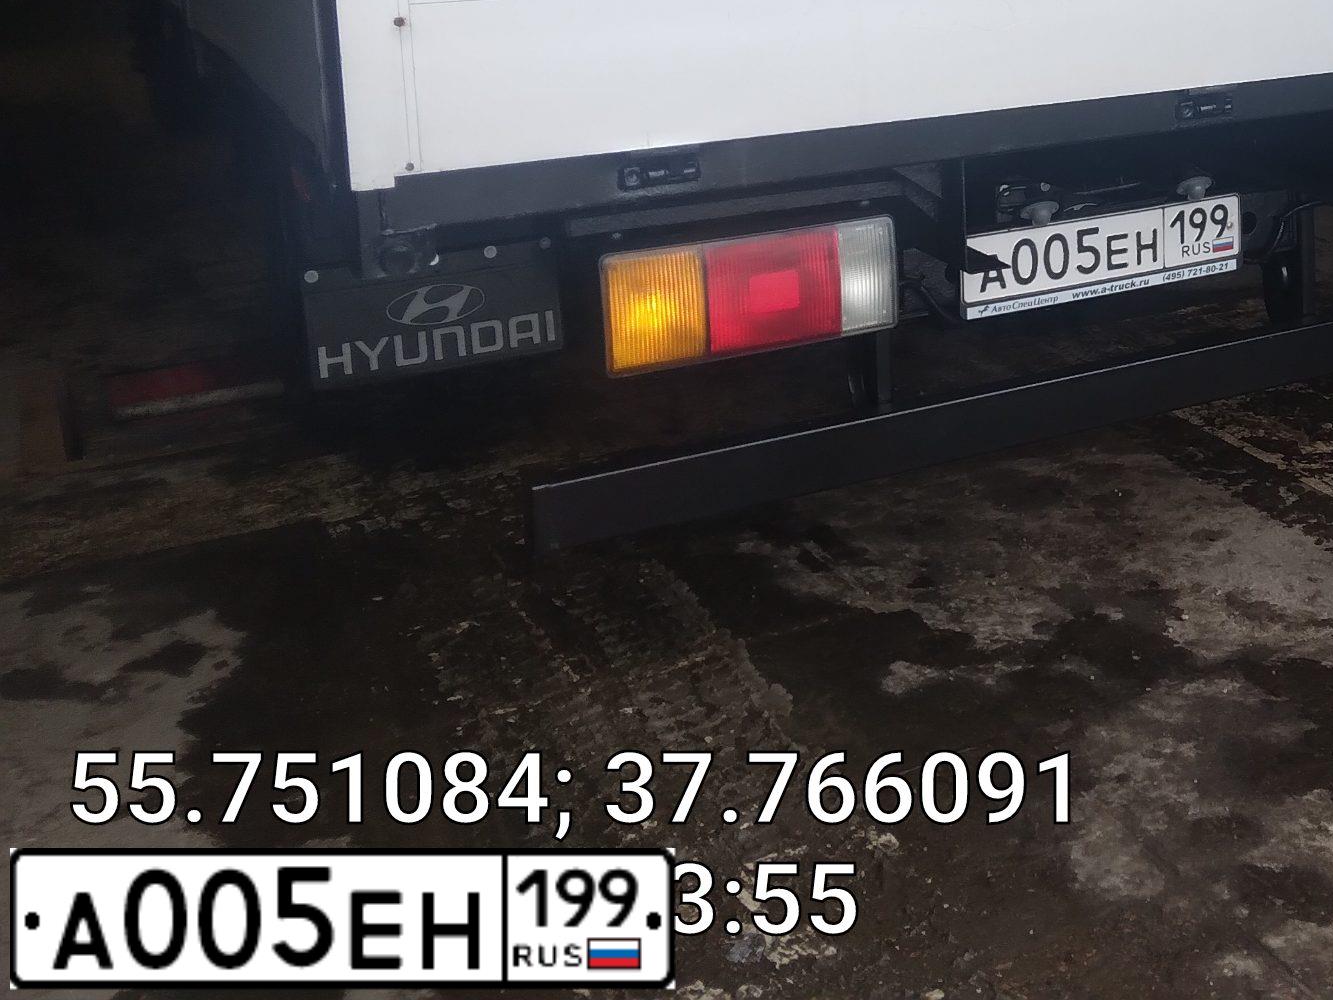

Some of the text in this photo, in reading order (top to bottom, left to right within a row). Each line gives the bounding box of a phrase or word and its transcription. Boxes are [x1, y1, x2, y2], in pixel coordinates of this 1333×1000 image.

[1169, 203, 1229, 246] 199
[1181, 240, 1212, 259] RUS
[1071, 277, 1150, 300] www.a-truck.ru
[1162, 269, 1185, 283] (495)
[1187, 262, 1229, 278] 721-80-21
[317, 310, 557, 379] HYUNDAI
